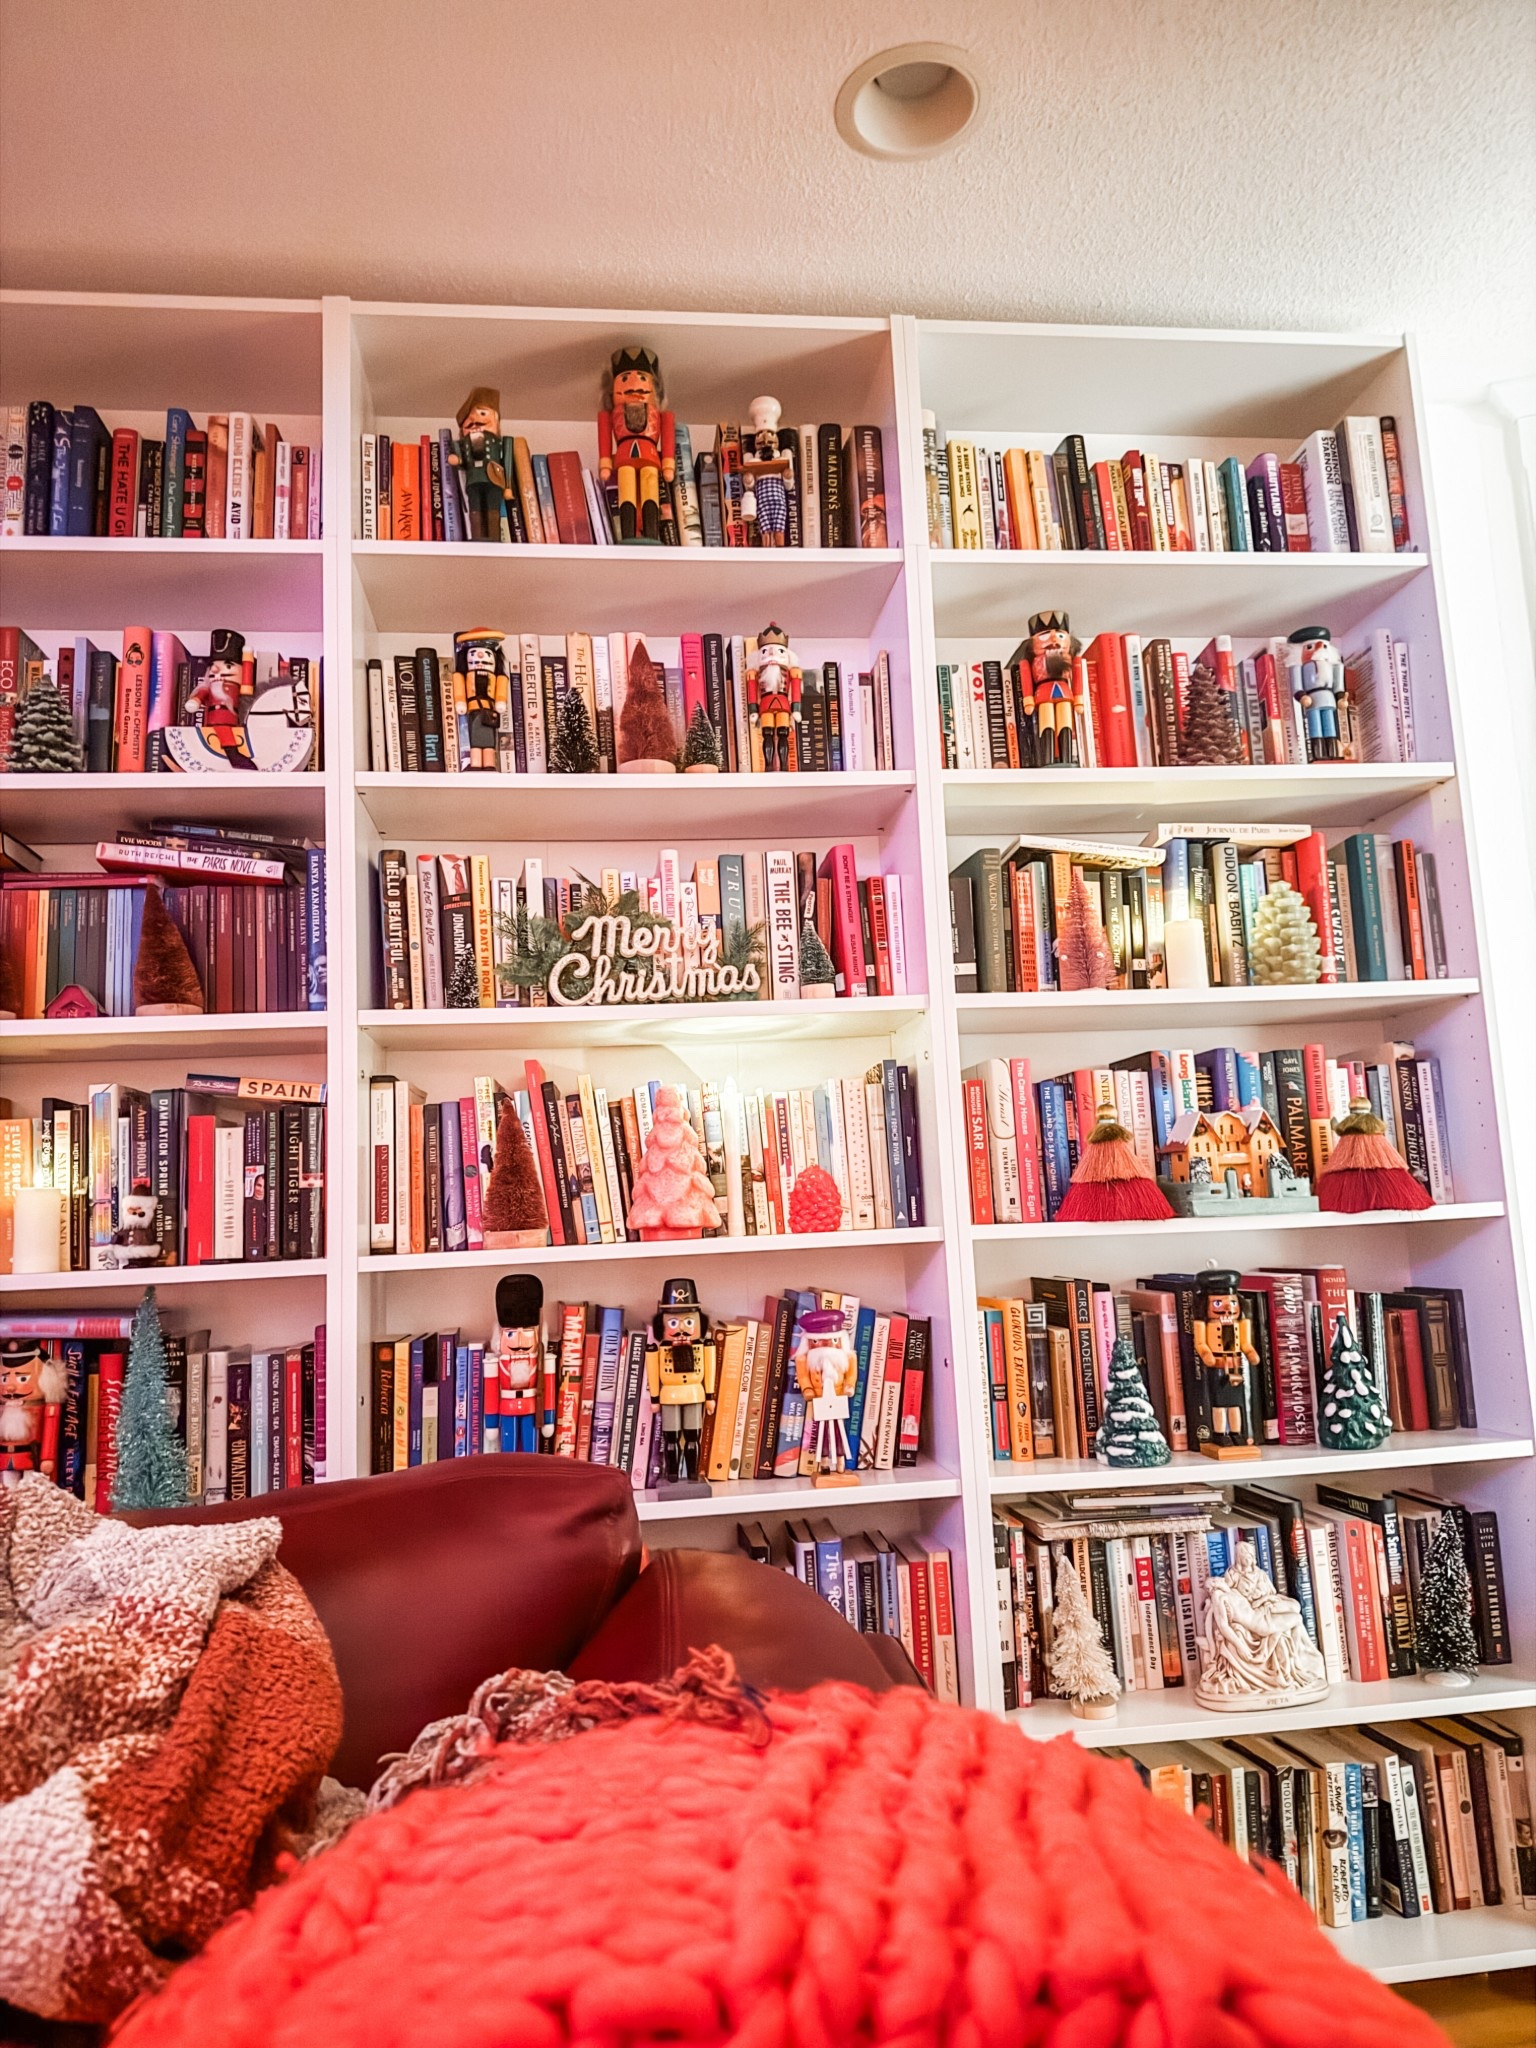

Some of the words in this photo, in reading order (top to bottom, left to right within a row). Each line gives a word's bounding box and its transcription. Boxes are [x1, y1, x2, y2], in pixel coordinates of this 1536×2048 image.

[675, 442, 685, 472] NORTH
[936, 448, 947, 467] THE
[1321, 436, 1334, 485] STARNONE
[1329, 436, 1342, 485] DOMENICO
[364, 488, 373, 509] DEAR
[679, 474, 689, 506] WOODS
[937, 471, 949, 497] PLOT
[1267, 461, 1282, 516] BEAUTYLAND
[1281, 469, 1292, 508] IRVING
[1292, 474, 1304, 504] JOHN
[364, 518, 373, 540] LIFE
[1, 660, 13, 689] ECO
[399, 661, 414, 692] WOLF
[423, 658, 432, 693] GABRIEL
[525, 653, 538, 709] LIBERTIE
[972, 664, 984, 702] VOX
[124, 688, 132, 714] Bonnie
[401, 695, 417, 715] HALL
[424, 695, 434, 720] SMITH
[444, 682, 453, 712] SUGAR
[1004, 680, 1012, 705] Celeste
[801, 720, 810, 733] Don
[1005, 706, 1014, 717] Ng
[123, 716, 131, 745] Garmus
[445, 715, 454, 739] CAGE
[527, 722, 535, 762] GREENIDGE
[425, 734, 439, 762] Brat
[802, 737, 812, 764] DeLillo
[135, 838, 161, 847] WOODS
[1205, 825, 1237, 833] JOURNAL
[117, 847, 140, 857] RUTH
[143, 850, 175, 861] REICHL
[308, 854, 317, 883] HANYA
[385, 861, 401, 896] HELLO
[664, 859, 676, 892] ROMANTIC
[666, 893, 677, 919] COMEDY
[773, 880, 790, 904] THE
[872, 879, 882, 906] COLSON
[308, 886, 318, 943] YANAGIHARA
[409, 886, 417, 937] CATASTROPHE
[479, 909, 488, 925] SIX
[775, 909, 792, 931] BEE
[387, 901, 403, 964] BEAUTIFUL
[452, 913, 466, 955] JONATHAN
[480, 928, 489, 953] DAYS
[571, 915, 719, 972] Merry
[850, 934, 858, 954] SUSAN
[875, 910, 887, 951] WHITEHEAD
[481, 956, 490, 967] IN
[777, 944, 795, 984] STING
[851, 956, 859, 976] MINOT
[482, 970, 491, 999] ROME
[548, 953, 762, 1007] Christmas
[1016, 1062, 1024, 1075] The
[1179, 1053, 1192, 1080] Long
[1282, 1057, 1299, 1065] GAYL
[244, 1080, 311, 1099] SPAIN
[887, 1069, 895, 1092] TRAVELS
[1017, 1078, 1026, 1106] Candy
[1180, 1079, 1194, 1110] Island
[1195, 1071, 1213, 1107] JAMES
[1399, 1066, 1413, 1111] HOSSEINI
[547, 1101, 556, 1122] JALAN
[639, 1092, 648, 1120] ROMAN
[778, 1103, 786, 1130] HOTEL
[1135, 1080, 1143, 1125] KEROUAC
[137, 1108, 147, 1140] Annie
[159, 1099, 168, 1156] DAMNATION
[890, 1118, 899, 1141] FRENCH
[972, 1117, 985, 1150] SARR
[1020, 1109, 1028, 1135] House
[12, 1134, 21, 1159] LOVE
[288, 1121, 299, 1161] NIGHT
[381, 1146, 387, 1158] ON
[892, 1143, 900, 1165] RIVIERA
[1405, 1122, 1419, 1168] ECHOED
[137, 1141, 147, 1177] PROULX
[556, 1158, 565, 1177] MARGO
[159, 1160, 168, 1196] SPRING
[288, 1166, 298, 1203] TIGER
[559, 1178, 568, 1208] WEINSTEIN
[1027, 1195, 1036, 1217] Egan
[156, 1205, 164, 1242] DAVIDSON
[1077, 1289, 1088, 1322] CIRCE
[1283, 1286, 1297, 1314] OVID
[863, 1325, 871, 1342] THE
[1010, 1306, 1023, 1352] GLORIOUS
[562, 1316, 583, 1376] MAAME
[632, 1337, 643, 1362] MAGGIE
[746, 1337, 754, 1356] PURE
[757, 1330, 771, 1360] ISABEL
[859, 1345, 868, 1371] GUEST
[871, 1324, 886, 1390] Swamplandia!
[888, 1338, 903, 1360] JULIA
[908, 1330, 917, 1360] CIRCUS
[915, 1332, 923, 1359] NIGHT
[1079, 1330, 1092, 1387] MADELINE
[255, 1360, 264, 1379] THE
[627, 1364, 639, 1400] O'FARRELL
[741, 1359, 752, 1393] COLOUR
[751, 1365, 765, 1403] ALLENDE
[1013, 1356, 1025, 1398] EXPLOITS
[1285, 1333, 1306, 1435] METAMORPHOSES
[255, 1381, 264, 1415] WATER
[380, 1369, 392, 1415] Rebecca
[853, 1381, 864, 1407] EMMA
[887, 1385, 895, 1417] SANDRA
[98, 1380, 108, 1435] LAUREN
[562, 1390, 578, 1427] JESSICA
[736, 1402, 745, 1427] SHEILA
[785, 1402, 795, 1443] WILKERSON
[793, 1403, 803, 1441] CHARMAINE
[1085, 1391, 1096, 1429] MILLER
[255, 1418, 264, 1446] CURE
[734, 1429, 742, 1447] HETI
[745, 1418, 759, 1458] VIOLETA
[850, 1410, 859, 1436] CLINE
[882, 1419, 892, 1456] NEWMAN
[65, 1448, 74, 1481] KILEY
[98, 1442, 108, 1481] ELKIN
[1384, 1513, 1397, 1534] Lisa
[825, 1552, 840, 1581] The
[1175, 1534, 1187, 1576] ANIMAL
[1272, 1532, 1286, 1593] ANTIQUITY
[1327, 1531, 1342, 1600] BIBLIOLEPSY
[1387, 1536, 1402, 1585] Scottoline
[1484, 1553, 1496, 1580] KATE
[917, 1567, 928, 1610] INTERIOR
[1139, 1560, 1148, 1598] FORD
[1181, 1598, 1192, 1620] LISA
[1393, 1595, 1411, 1649] LOYALTY
[1487, 1585, 1502, 1637] ATKINSON
[920, 1614, 930, 1668] CHINATOWN
[1144, 1603, 1156, 1654] Independence
[1183, 1621, 1197, 1661] TADDEO
[1148, 1657, 1157, 1670] Day
[1335, 1785, 1343, 1817] SAVAGE
[1340, 1858, 1349, 1901] ROBERTO
